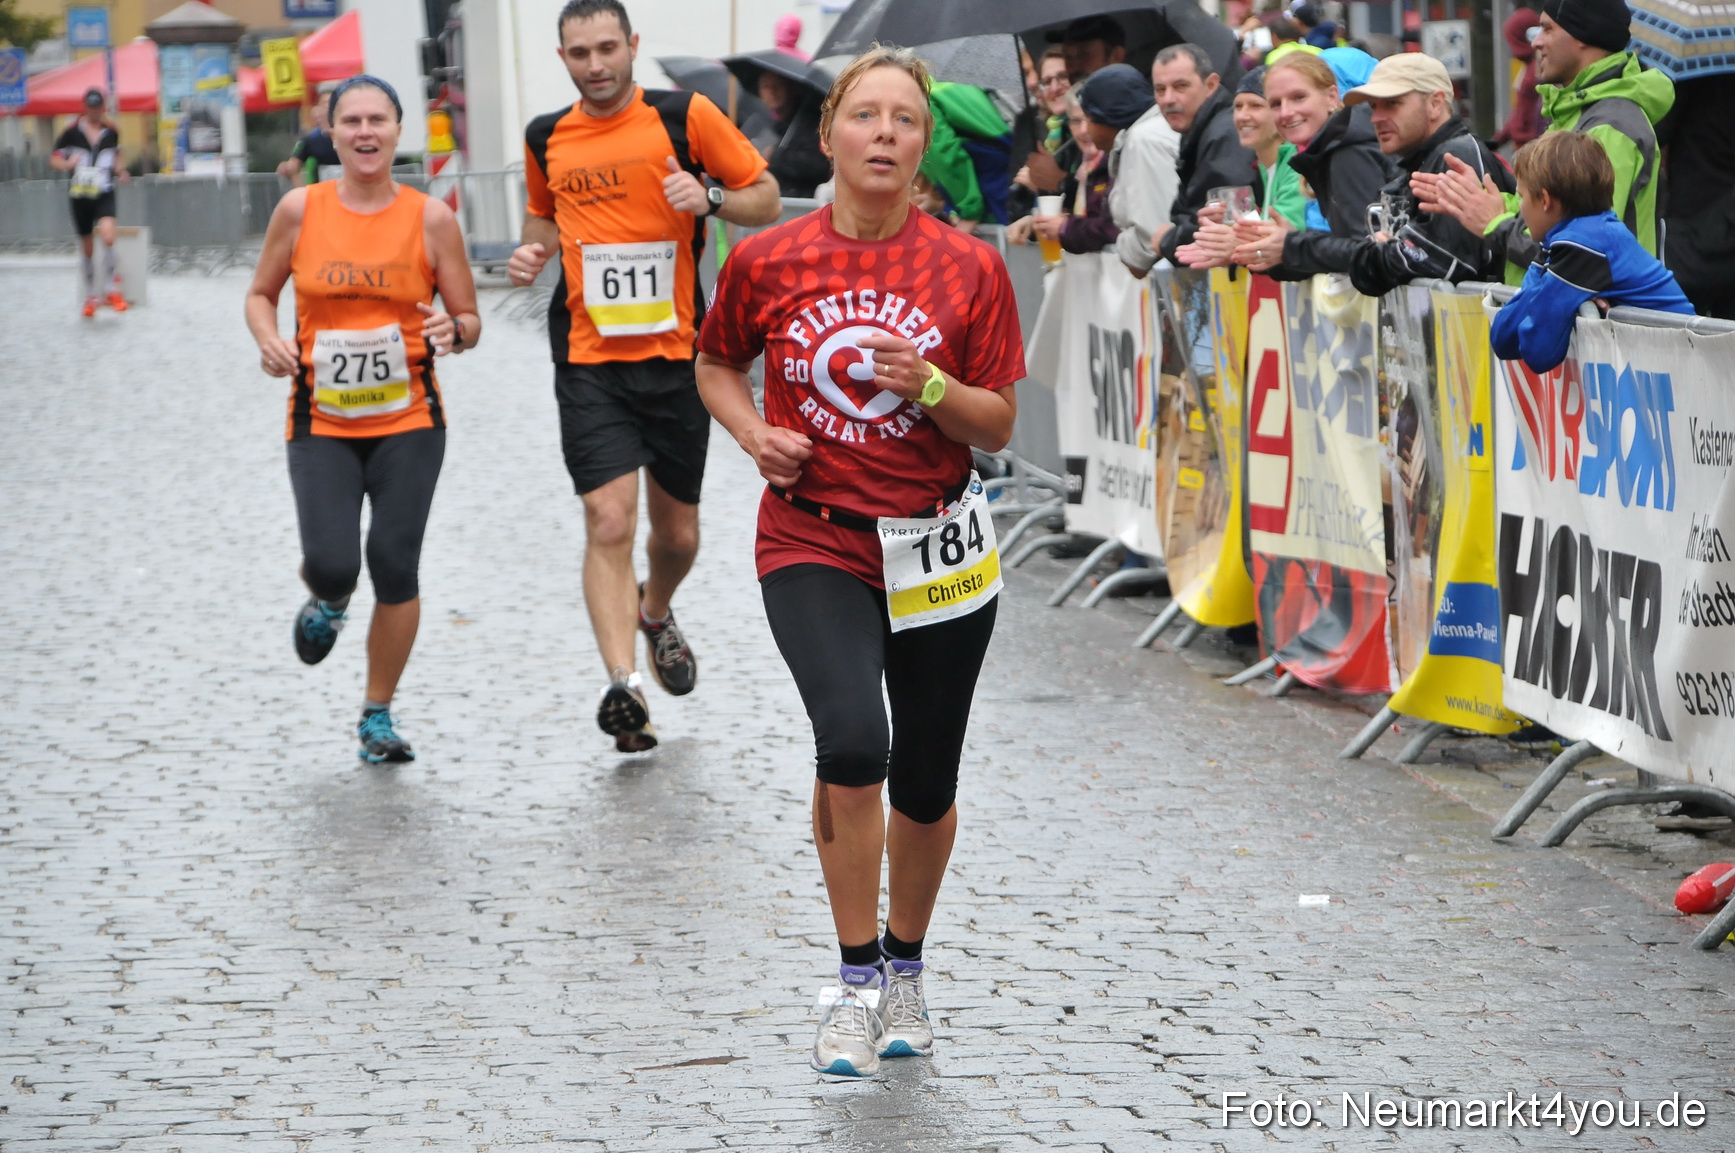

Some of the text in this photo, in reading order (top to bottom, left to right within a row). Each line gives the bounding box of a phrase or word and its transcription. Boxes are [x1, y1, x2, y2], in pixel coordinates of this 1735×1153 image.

[567, 169, 626, 193] OEXL
[584, 251, 662, 262] PARTL Neumarkt
[327, 270, 390, 287] OEXL
[602, 265, 656, 300] 611
[787, 289, 943, 357] FINISHER
[344, 337, 388, 348] Neumarkt
[331, 350, 390, 384] 275
[784, 357, 809, 383] 20
[339, 392, 385, 406] Monika
[798, 396, 924, 443] RELAY TEAM
[1689, 416, 1735, 479] Kasteng
[881, 526, 924, 538] PARTL
[912, 508, 984, 574] 184
[891, 582, 898, 592] C
[927, 573, 983, 604] Christa
[1676, 671, 1734, 719] 92318
